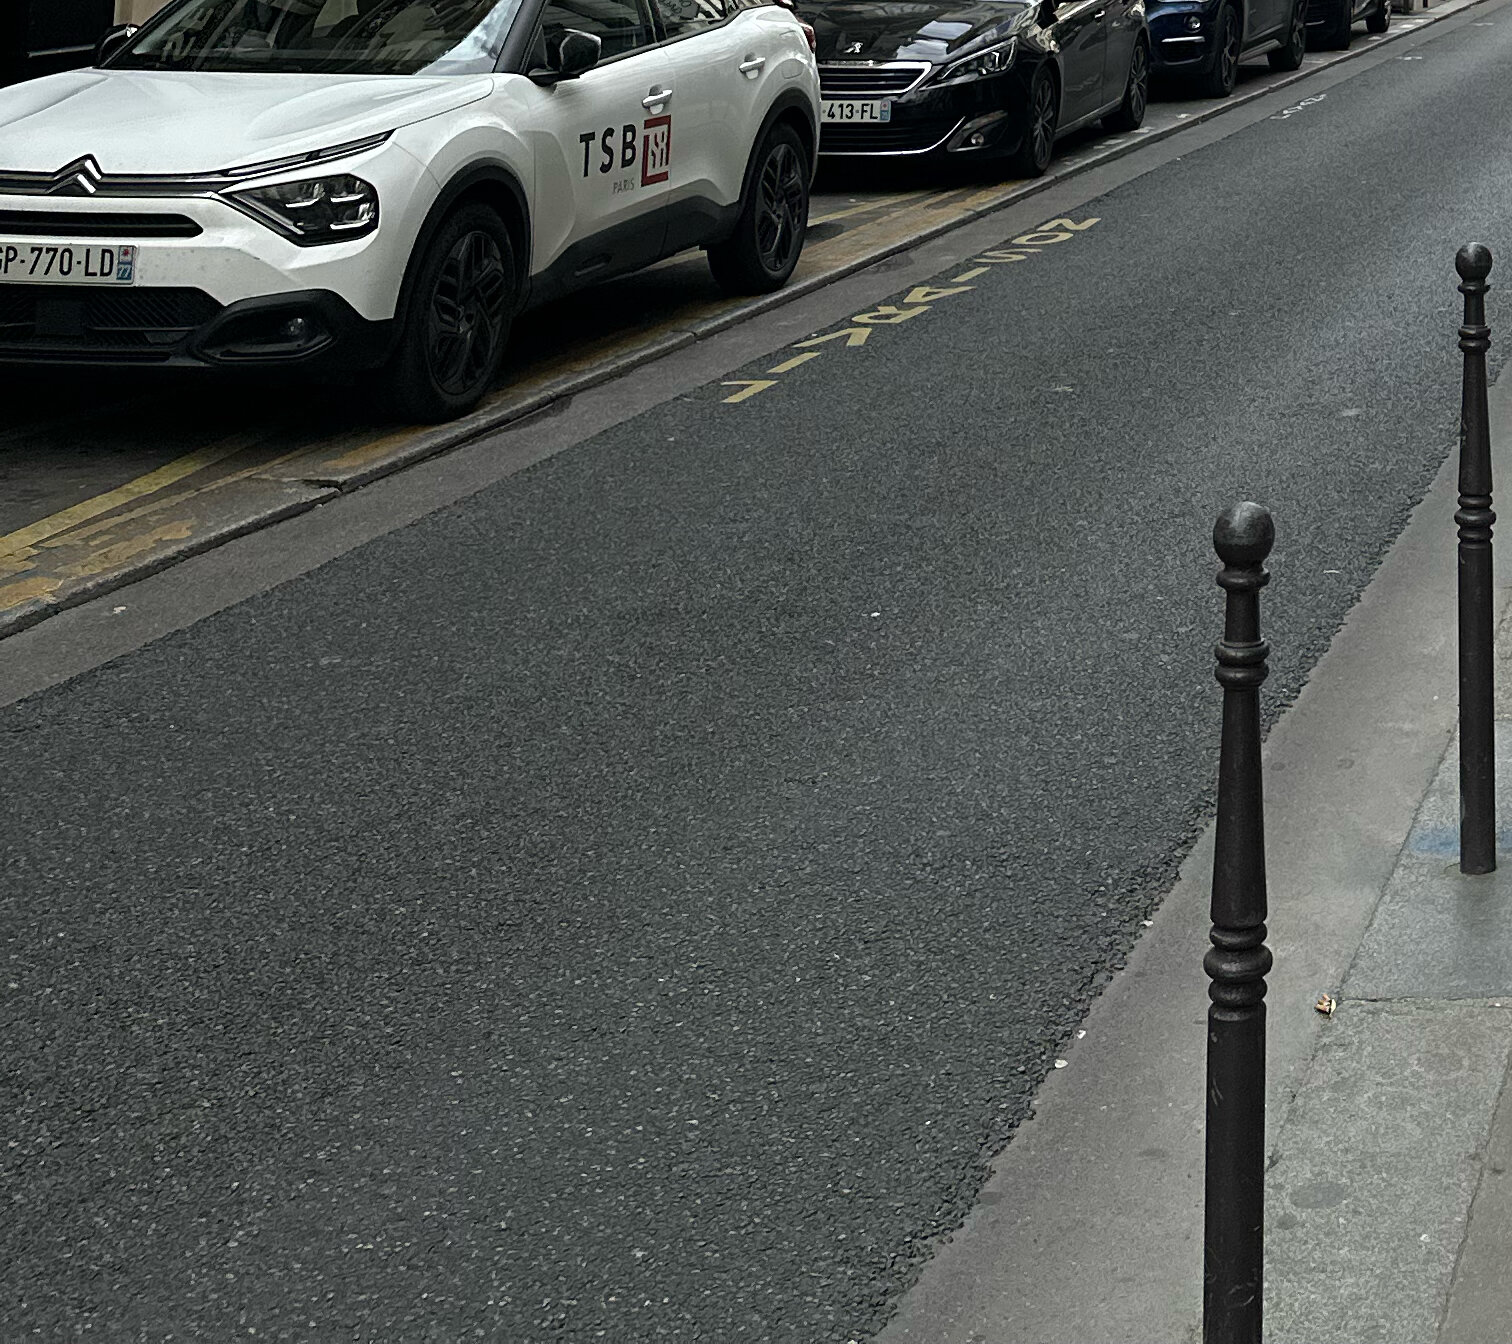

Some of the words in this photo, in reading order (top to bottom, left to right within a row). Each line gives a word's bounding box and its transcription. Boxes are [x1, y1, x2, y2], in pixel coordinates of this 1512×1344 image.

[579, 123, 637, 178] TSB
[612, 178, 635, 193] PARIS
[0, 245, 115, 278] P-770-LD
[720, 217, 1102, 404] LIVRAISON
